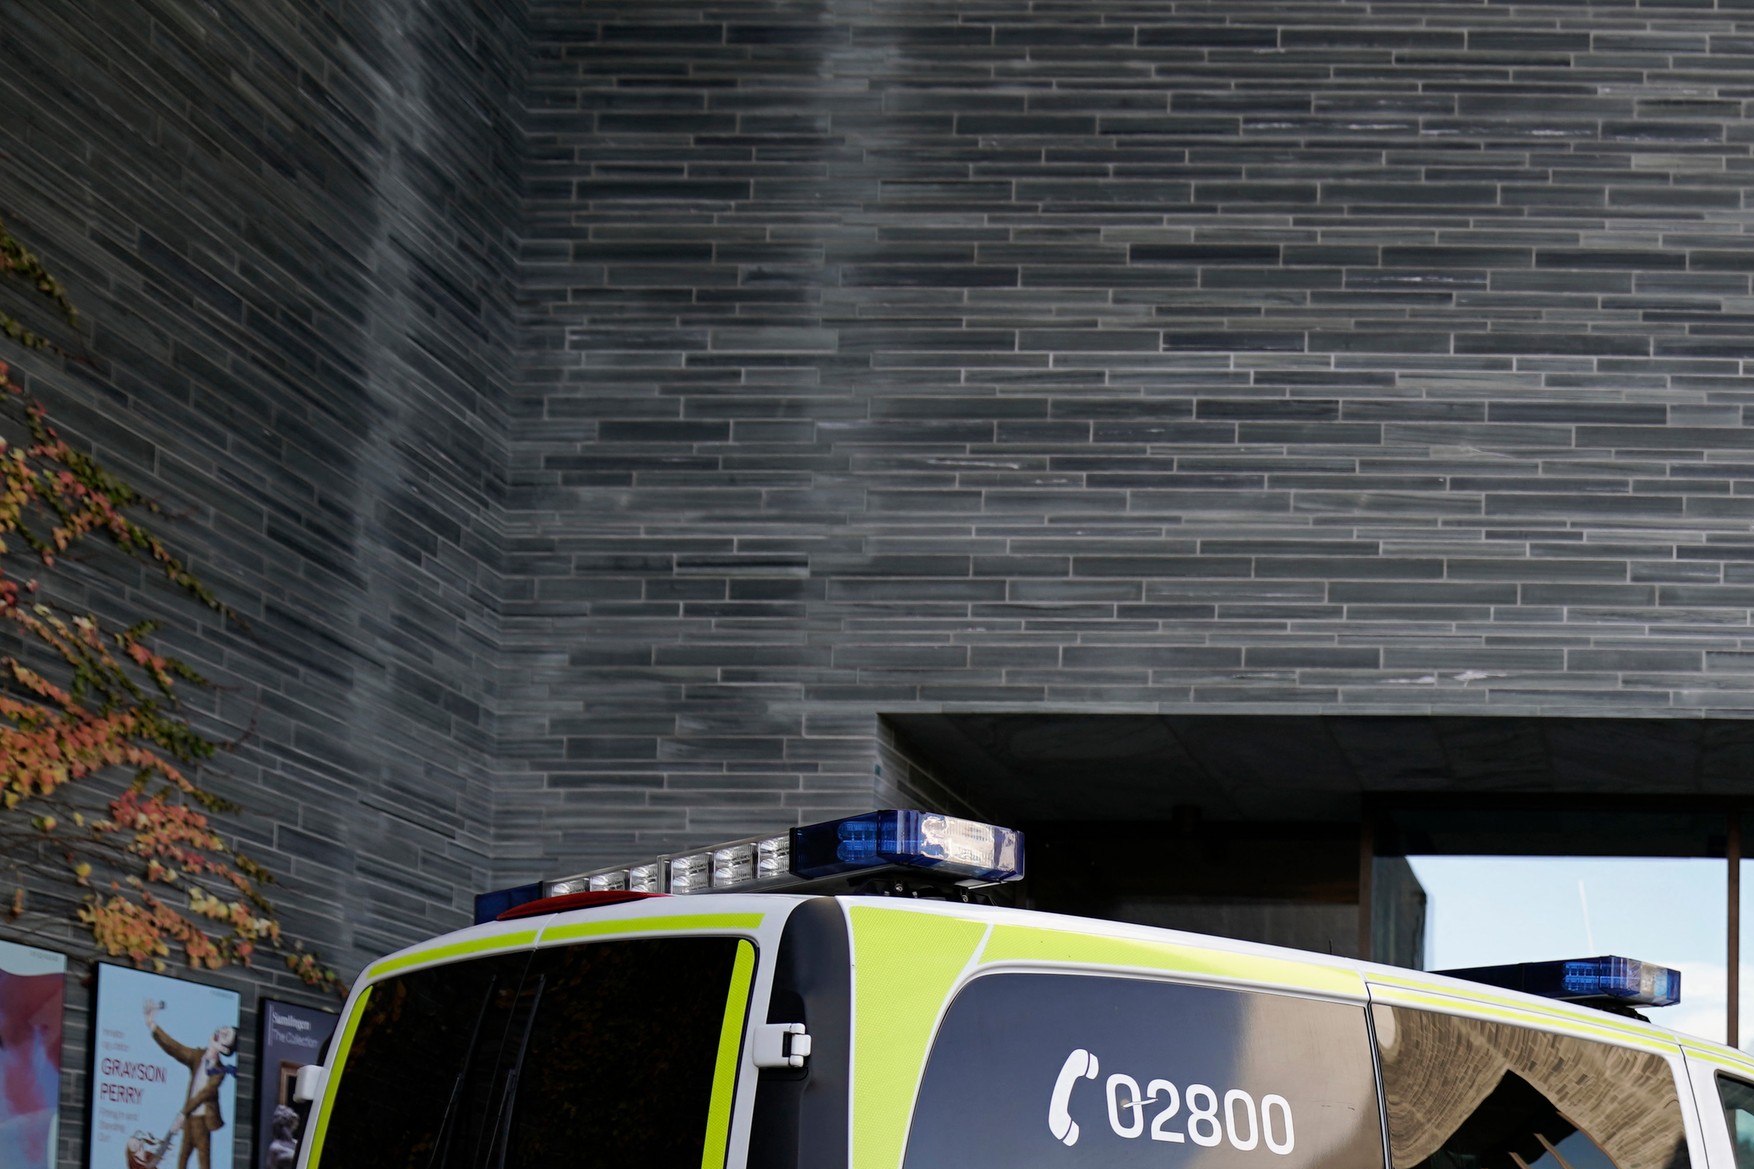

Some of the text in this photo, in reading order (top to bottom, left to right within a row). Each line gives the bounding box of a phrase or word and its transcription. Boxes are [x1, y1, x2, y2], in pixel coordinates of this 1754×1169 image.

[101, 1057, 167, 1083] GRAYSON
[101, 1083, 143, 1104] PERRY
[1106, 1073, 1295, 1155] 02800
